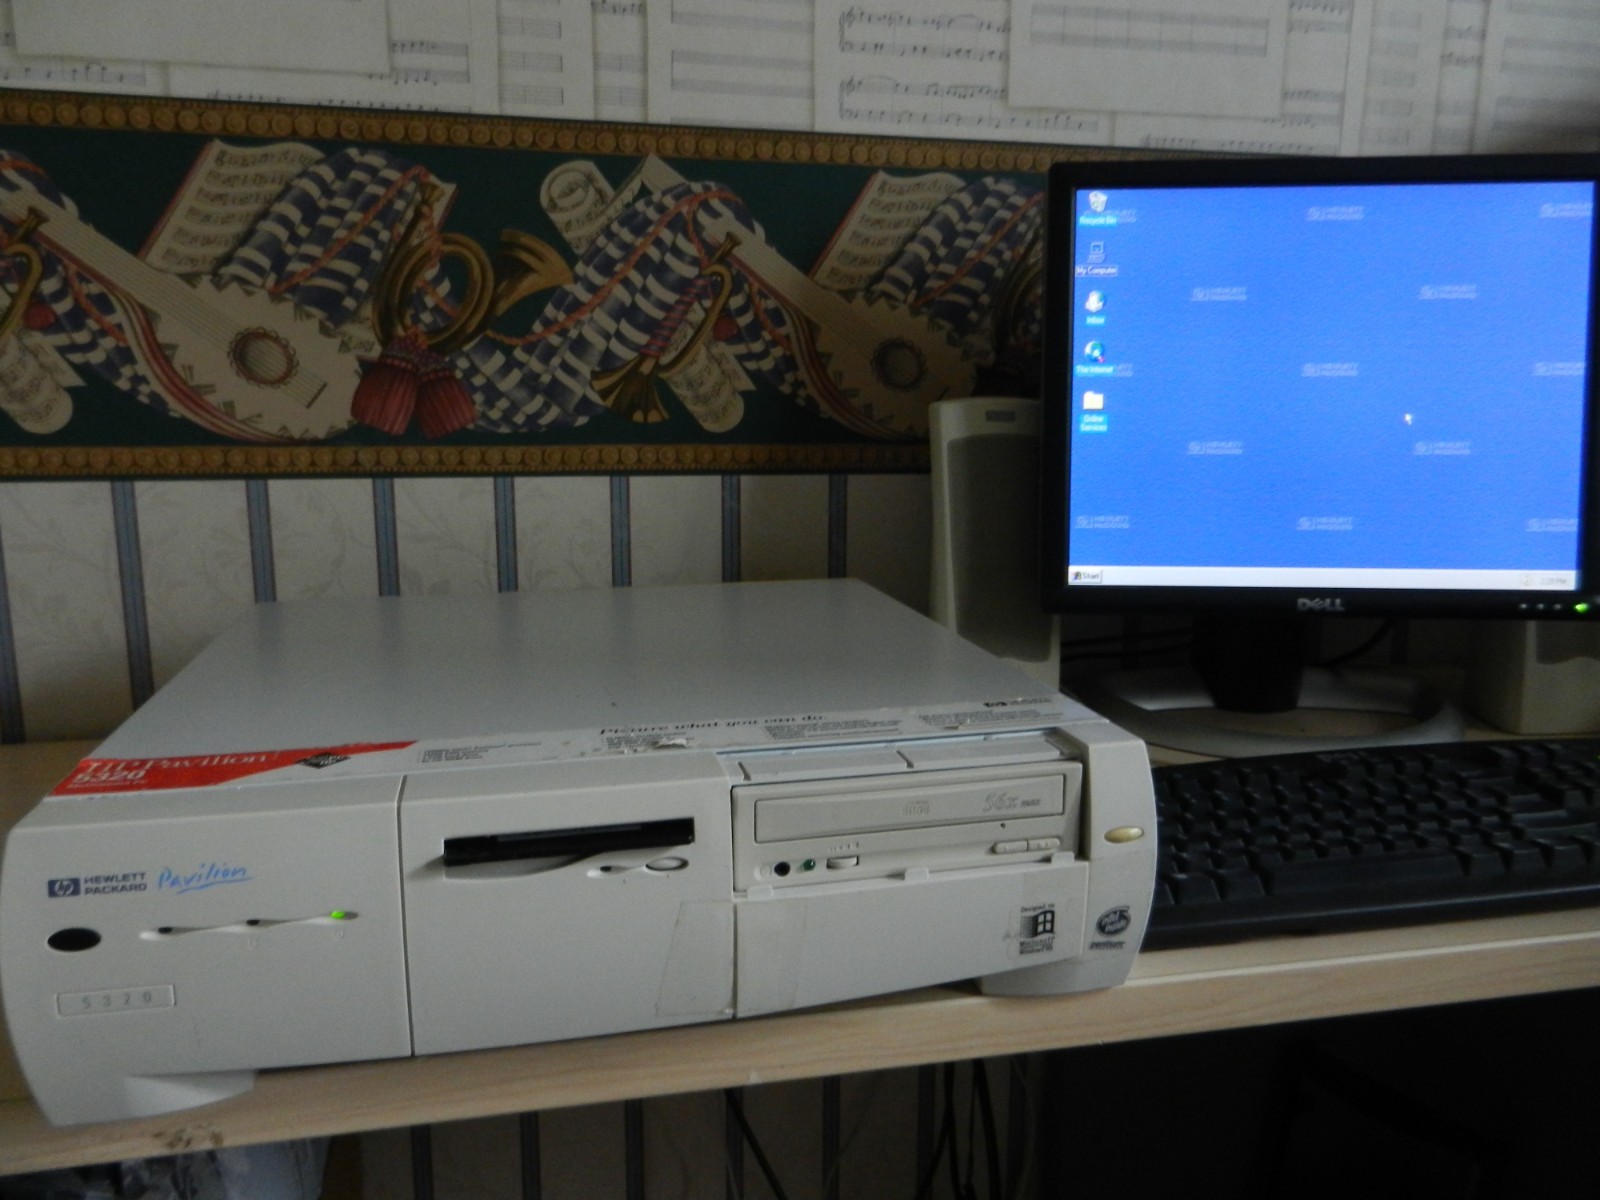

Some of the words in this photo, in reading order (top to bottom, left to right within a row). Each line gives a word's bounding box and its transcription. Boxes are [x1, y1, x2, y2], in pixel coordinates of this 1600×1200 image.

[1297, 598, 1345, 611] DELL
[83, 871, 147, 885] HEWLETT
[158, 862, 247, 890] Pavilion
[84, 883, 148, 896] PACKARD
